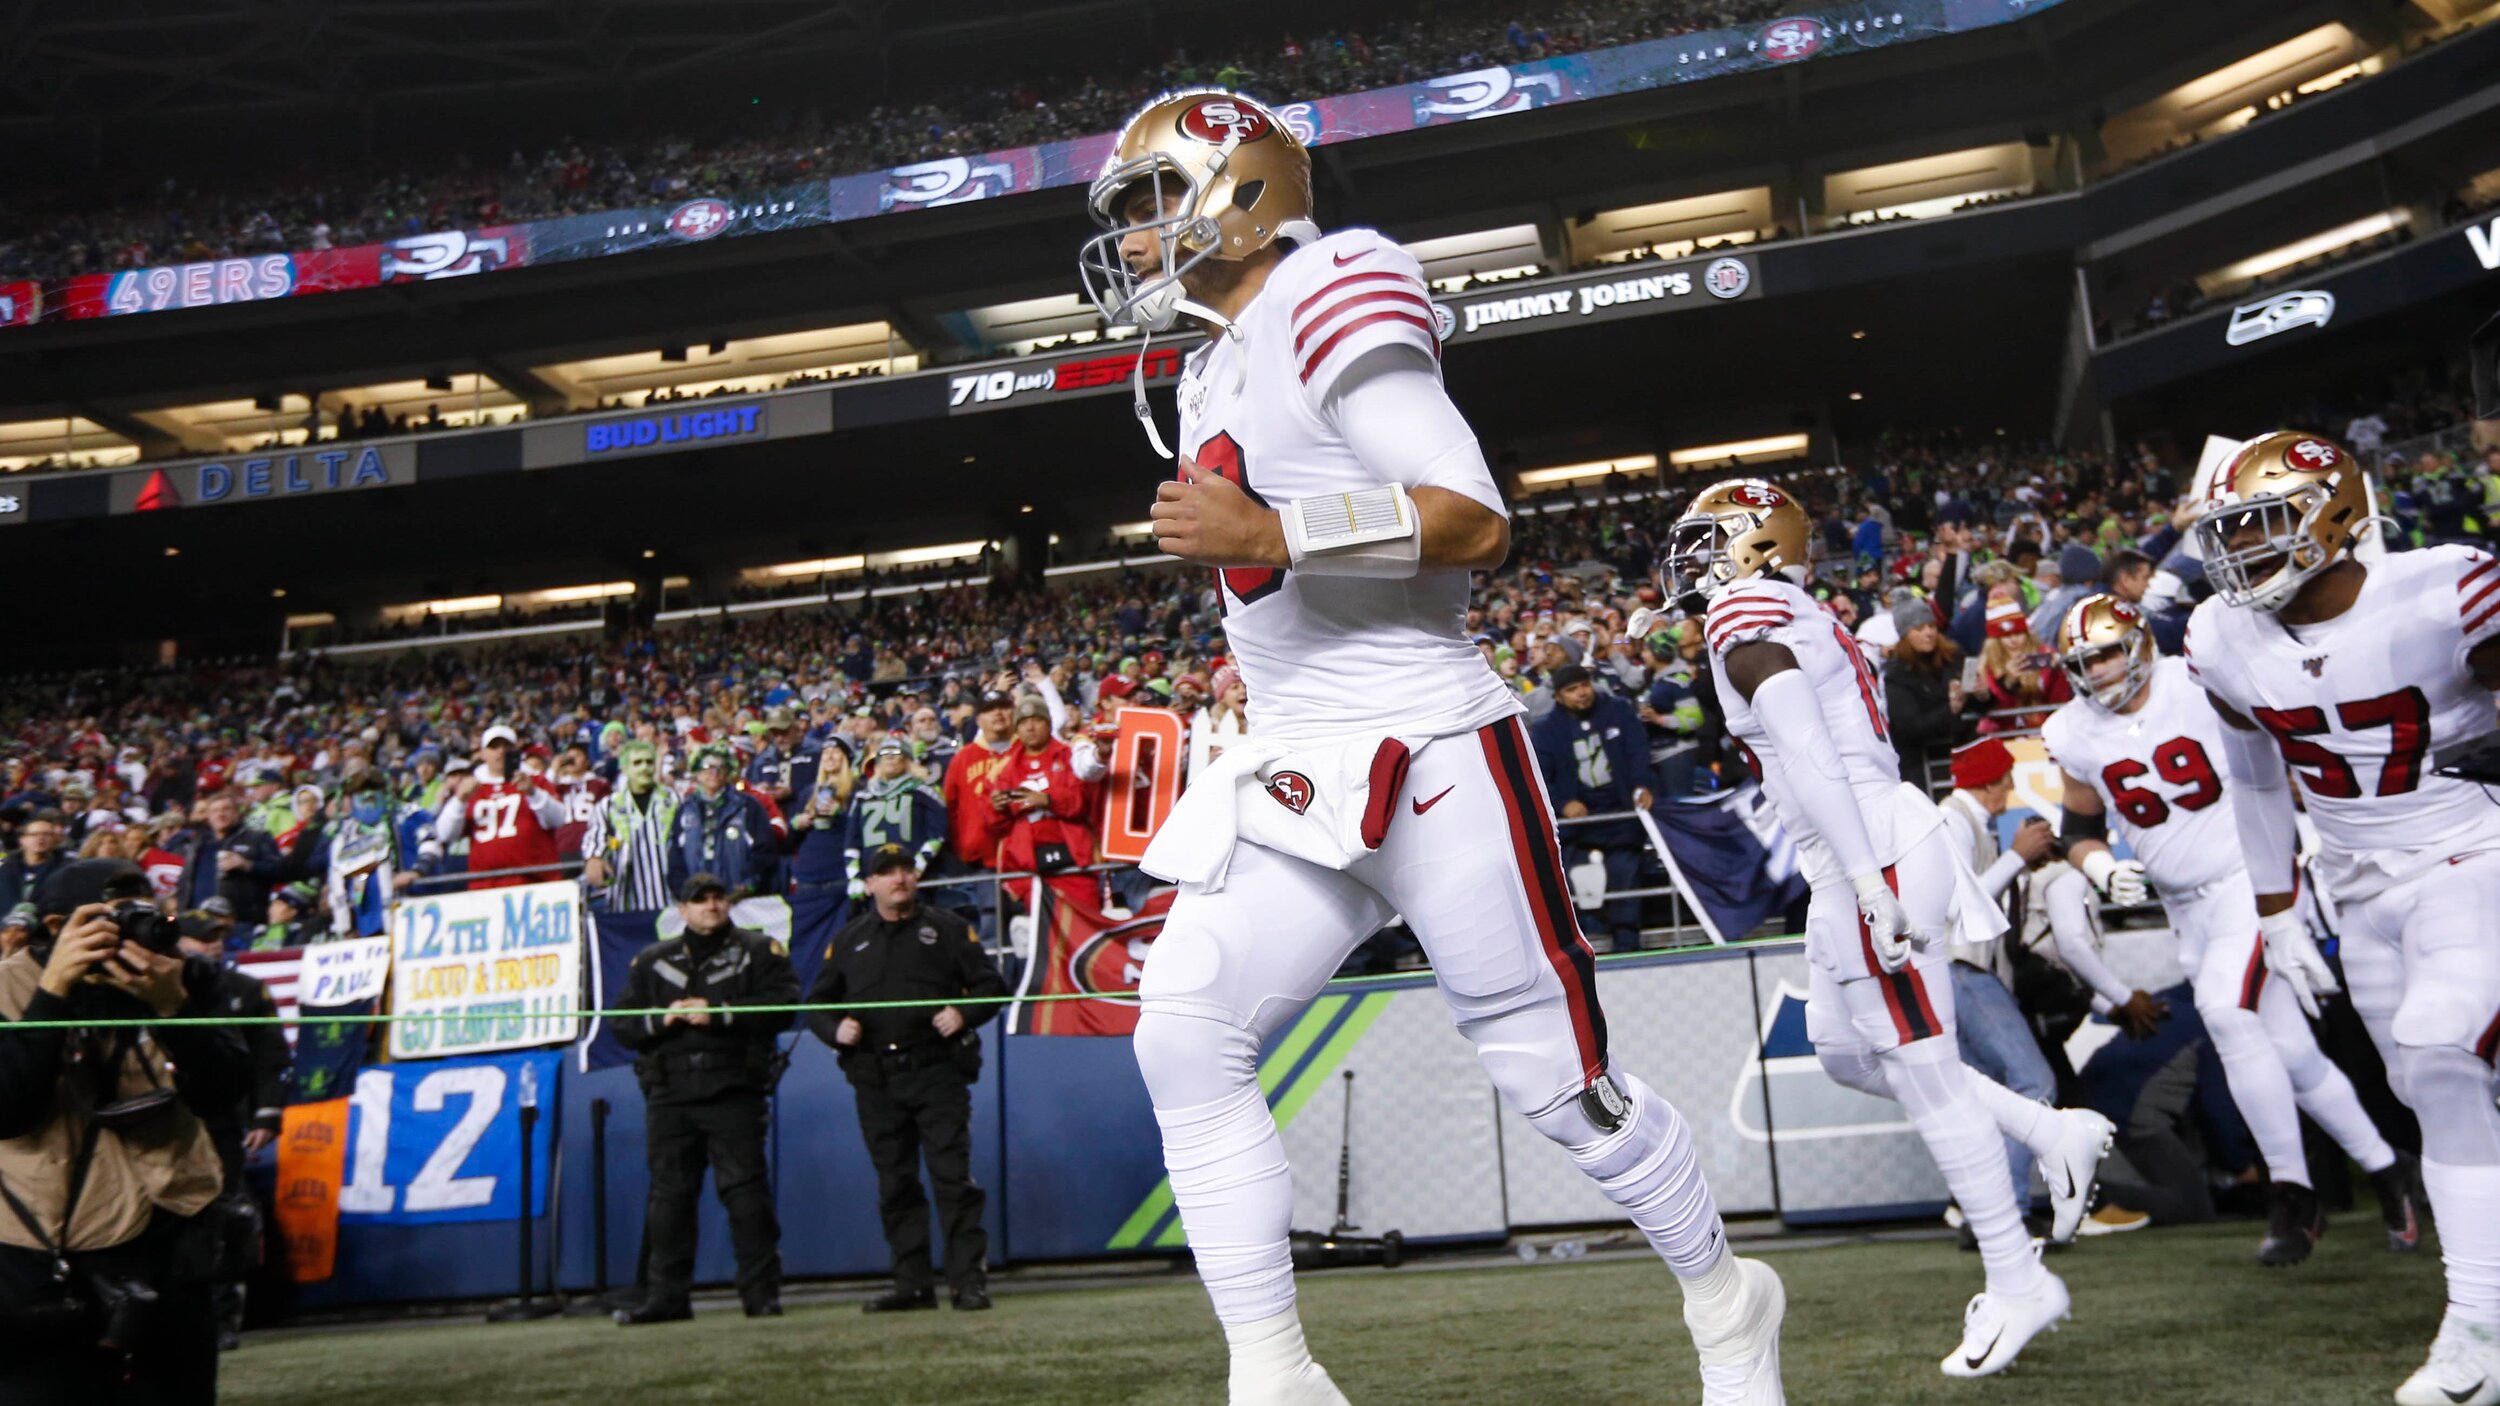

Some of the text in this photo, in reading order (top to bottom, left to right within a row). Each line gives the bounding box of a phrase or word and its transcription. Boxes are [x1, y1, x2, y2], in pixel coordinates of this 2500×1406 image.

[110, 253, 292, 313] 49ERS
[1464, 272, 1692, 332] JIMMY JOHN'S
[950, 371, 1015, 406] 710
[1055, 347, 1179, 391] ESPN
[587, 405, 761, 451] BUD LIGHT
[199, 447, 389, 499] DELTA
[2251, 685, 2431, 798] 57
[2101, 735, 2223, 829] 69
[473, 793, 521, 843] 97
[861, 794, 913, 848] 24
[501, 890, 572, 951] Man
[411, 953, 559, 1000] LOUD & PROUD
[401, 1008, 435, 1052] GO
[441, 999, 525, 1047] HAWKS
[339, 1065, 507, 1213] 12
